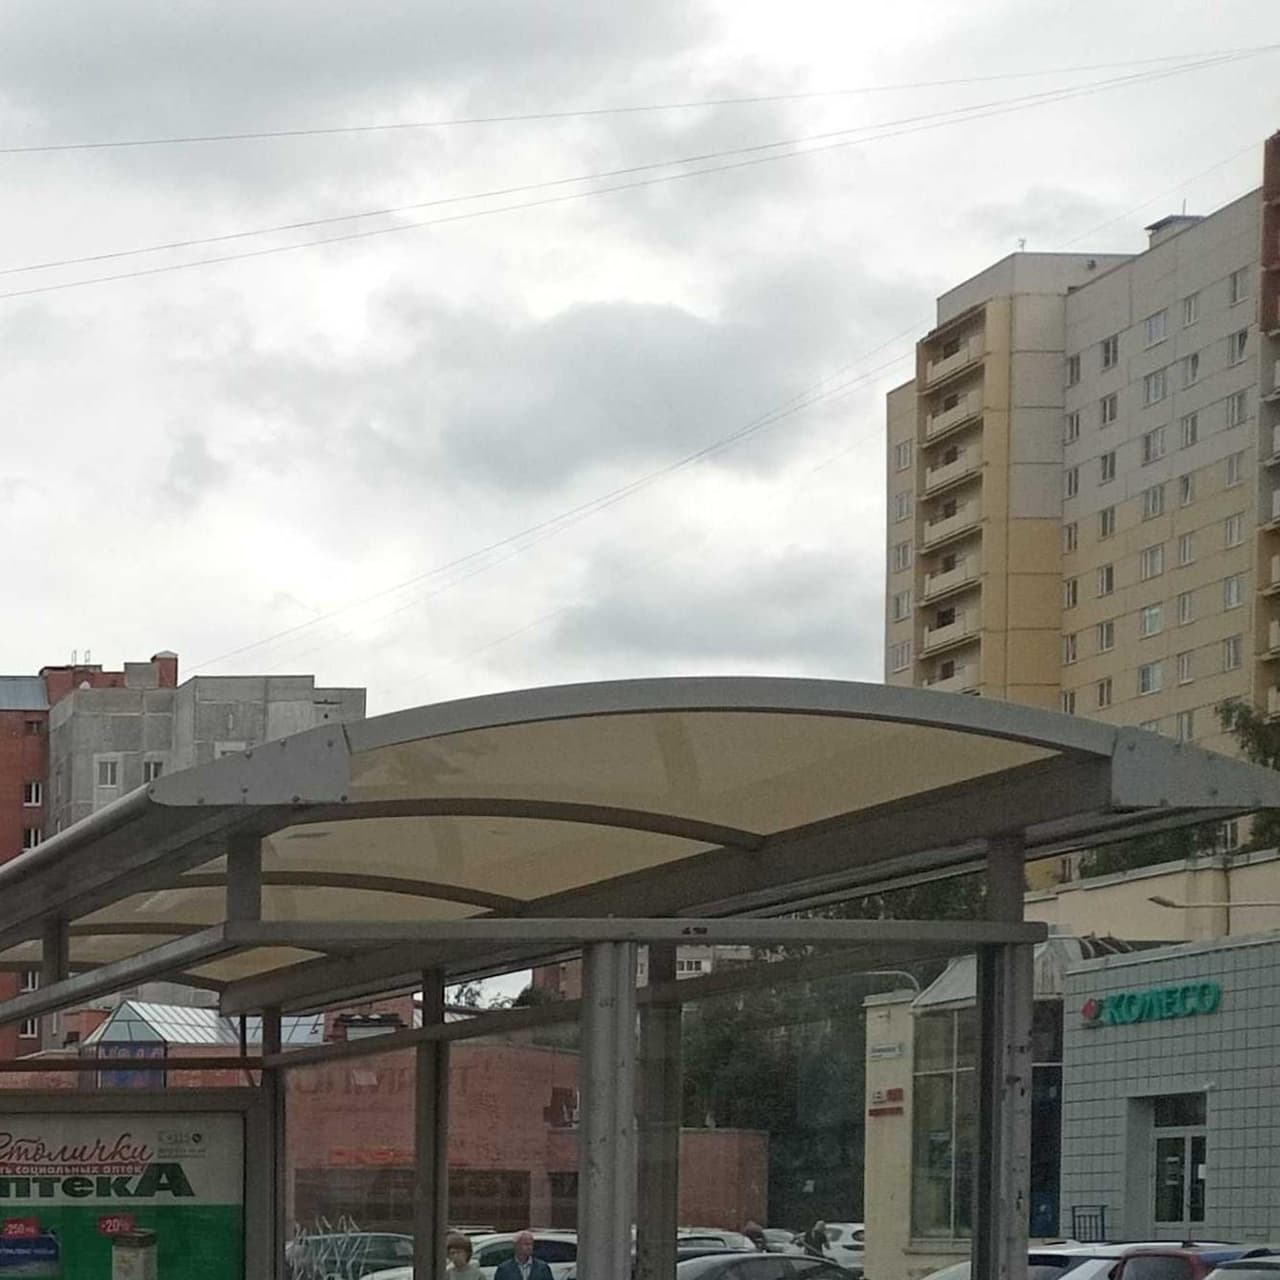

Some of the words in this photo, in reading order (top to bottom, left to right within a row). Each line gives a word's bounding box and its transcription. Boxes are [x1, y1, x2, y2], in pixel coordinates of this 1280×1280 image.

[1104, 982, 1221, 1025] КОЛЕСО
[15, 1164, 99, 1176] социальных
[102, 1164, 142, 1175] аптек
[100, 1219, 131, 1233] -20%
